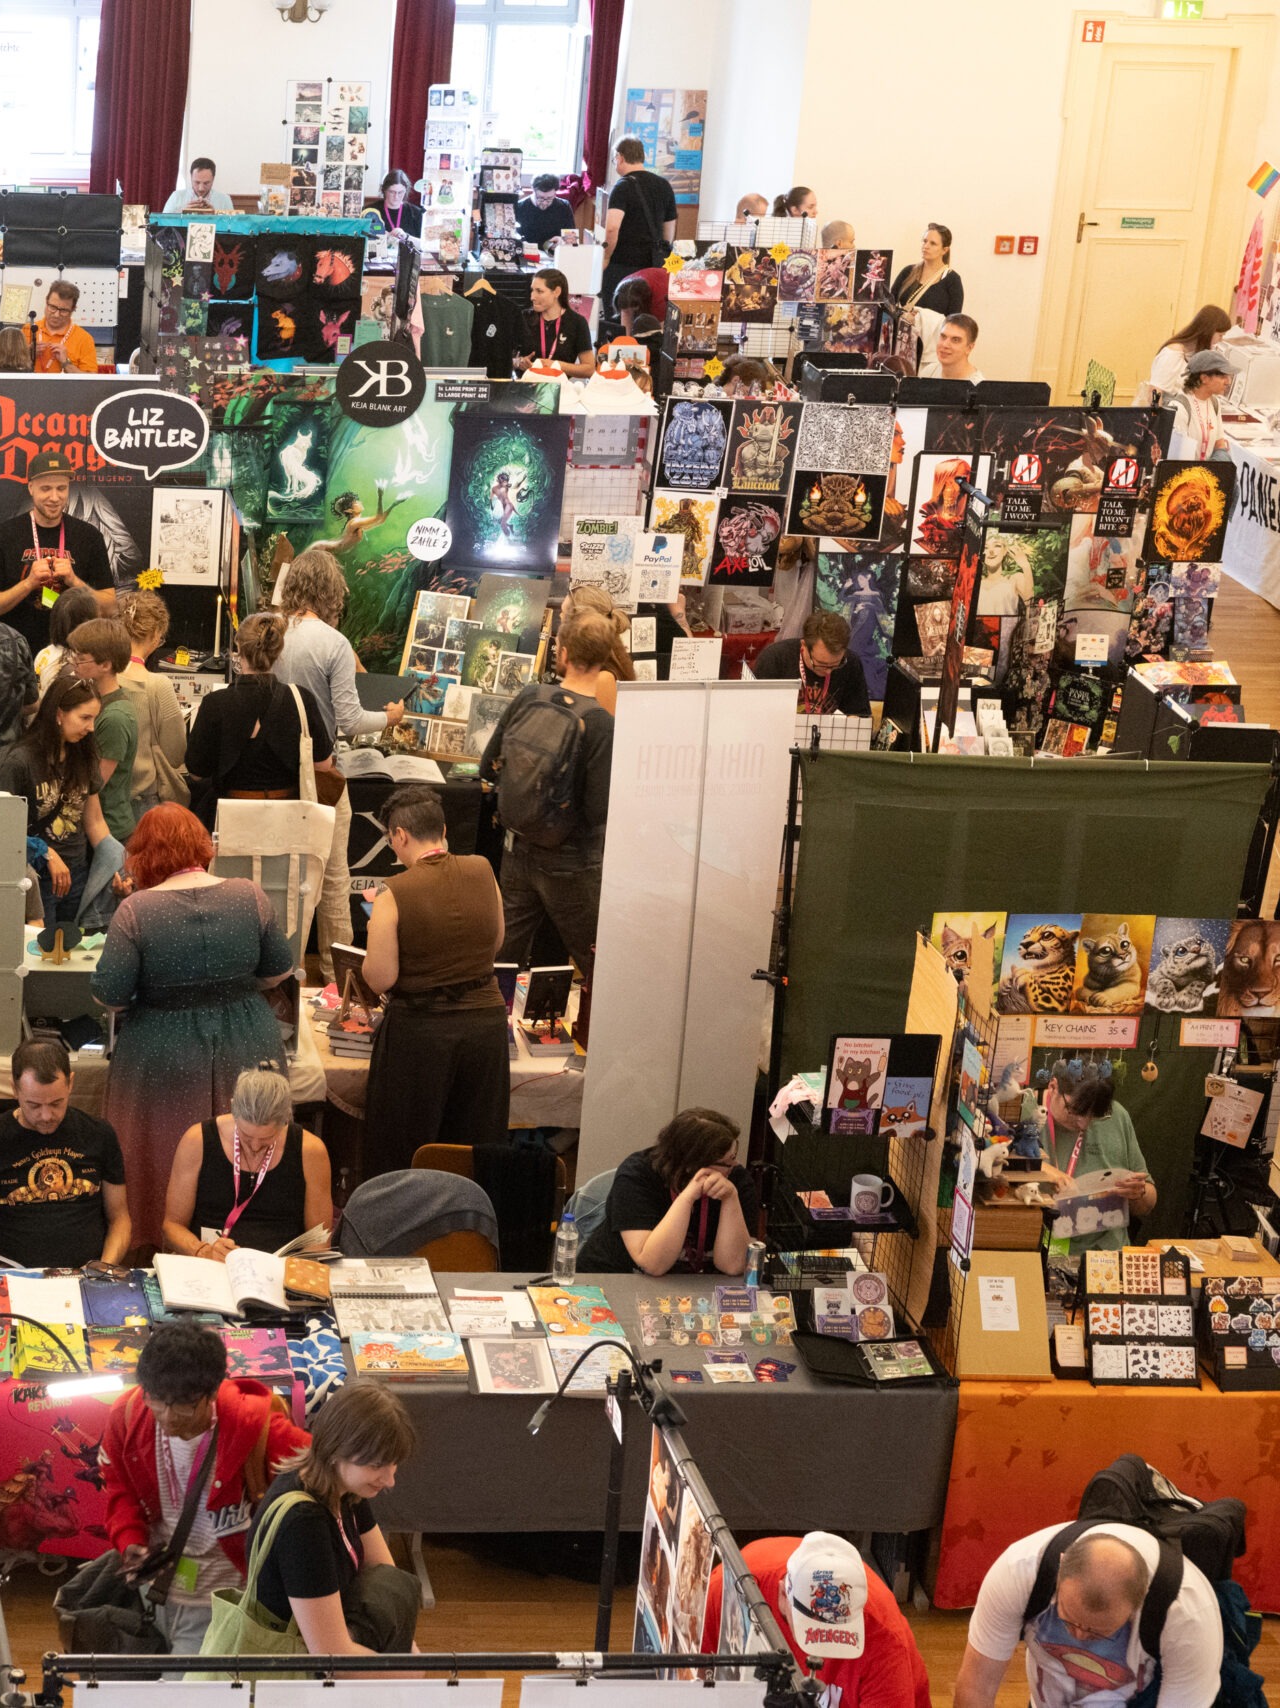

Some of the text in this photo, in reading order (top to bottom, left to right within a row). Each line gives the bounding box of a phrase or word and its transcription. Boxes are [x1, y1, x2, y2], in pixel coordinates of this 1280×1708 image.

[351, 401, 407, 413] KEJA BLANK ART
[128, 407, 165, 427] LIZ
[104, 428, 198, 450] BAITLER
[1240, 461, 1280, 533] PANE
[415, 525, 440, 535] NIMM
[576, 520, 618, 535] ZOMBIE!
[410, 536, 448, 549] ZAHLE 2
[644, 555, 672, 563] PayPal
[1045, 1024, 1128, 1036] KEY CHAINS 35 €
[894, 1081, 915, 1089] Give
[892, 1087, 911, 1096] food
[63, 1147, 85, 1159] Mayer
[28, 1399, 73, 1413] RETURNS
[805, 1628, 857, 1646] AVENGERS
